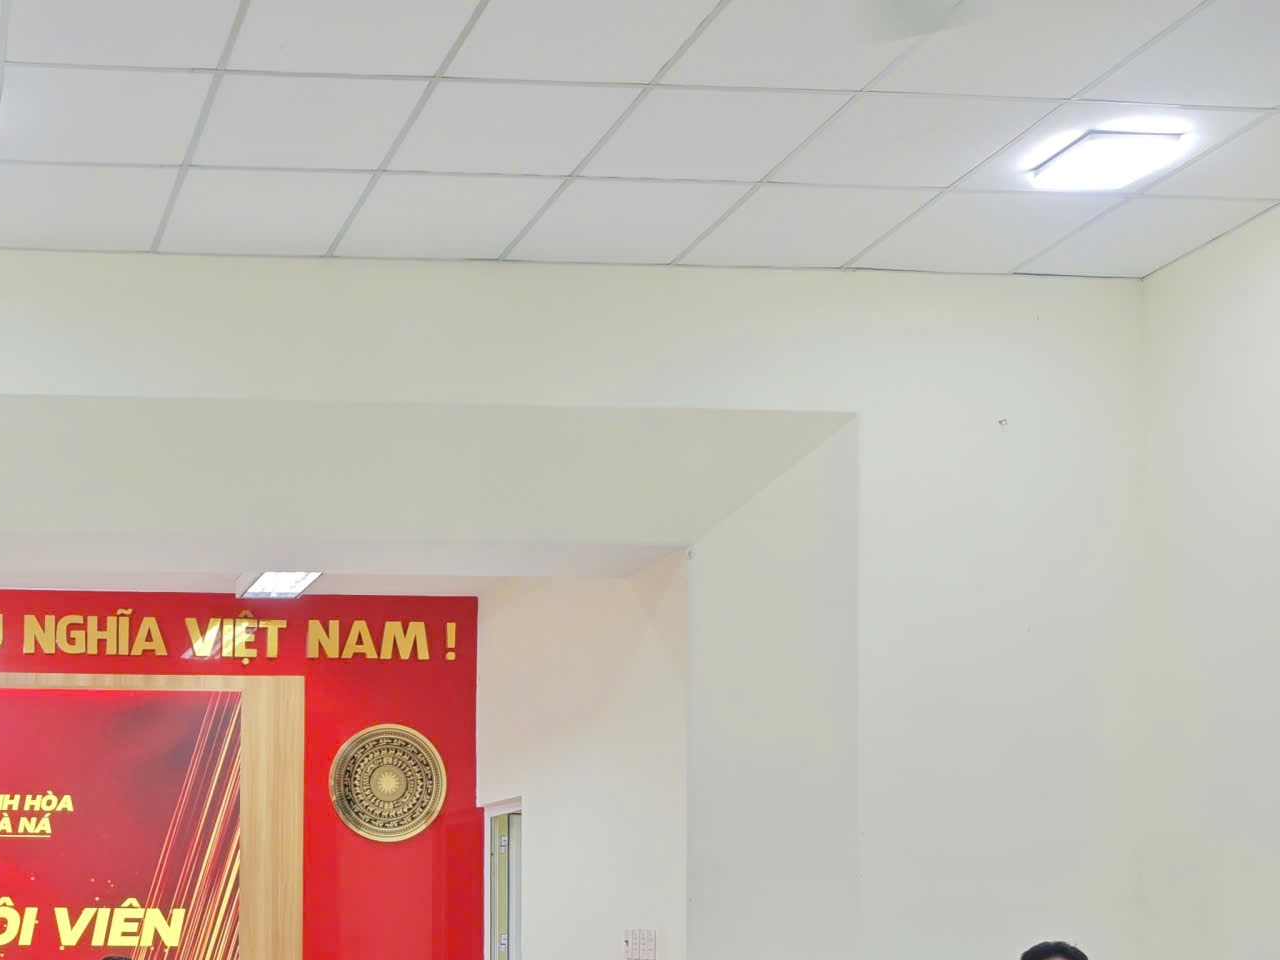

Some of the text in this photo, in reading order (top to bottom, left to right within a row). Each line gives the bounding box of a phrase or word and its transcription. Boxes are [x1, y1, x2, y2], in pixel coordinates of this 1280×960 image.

[22, 608, 168, 656] NGHĨA
[185, 609, 287, 665] VIỆT
[306, 619, 430, 660] NAM
[444, 622, 457, 661] !
[23, 790, 74, 812] HÒA
[17, 813, 53, 833] NÁ
[54, 897, 186, 947] VIÊN
